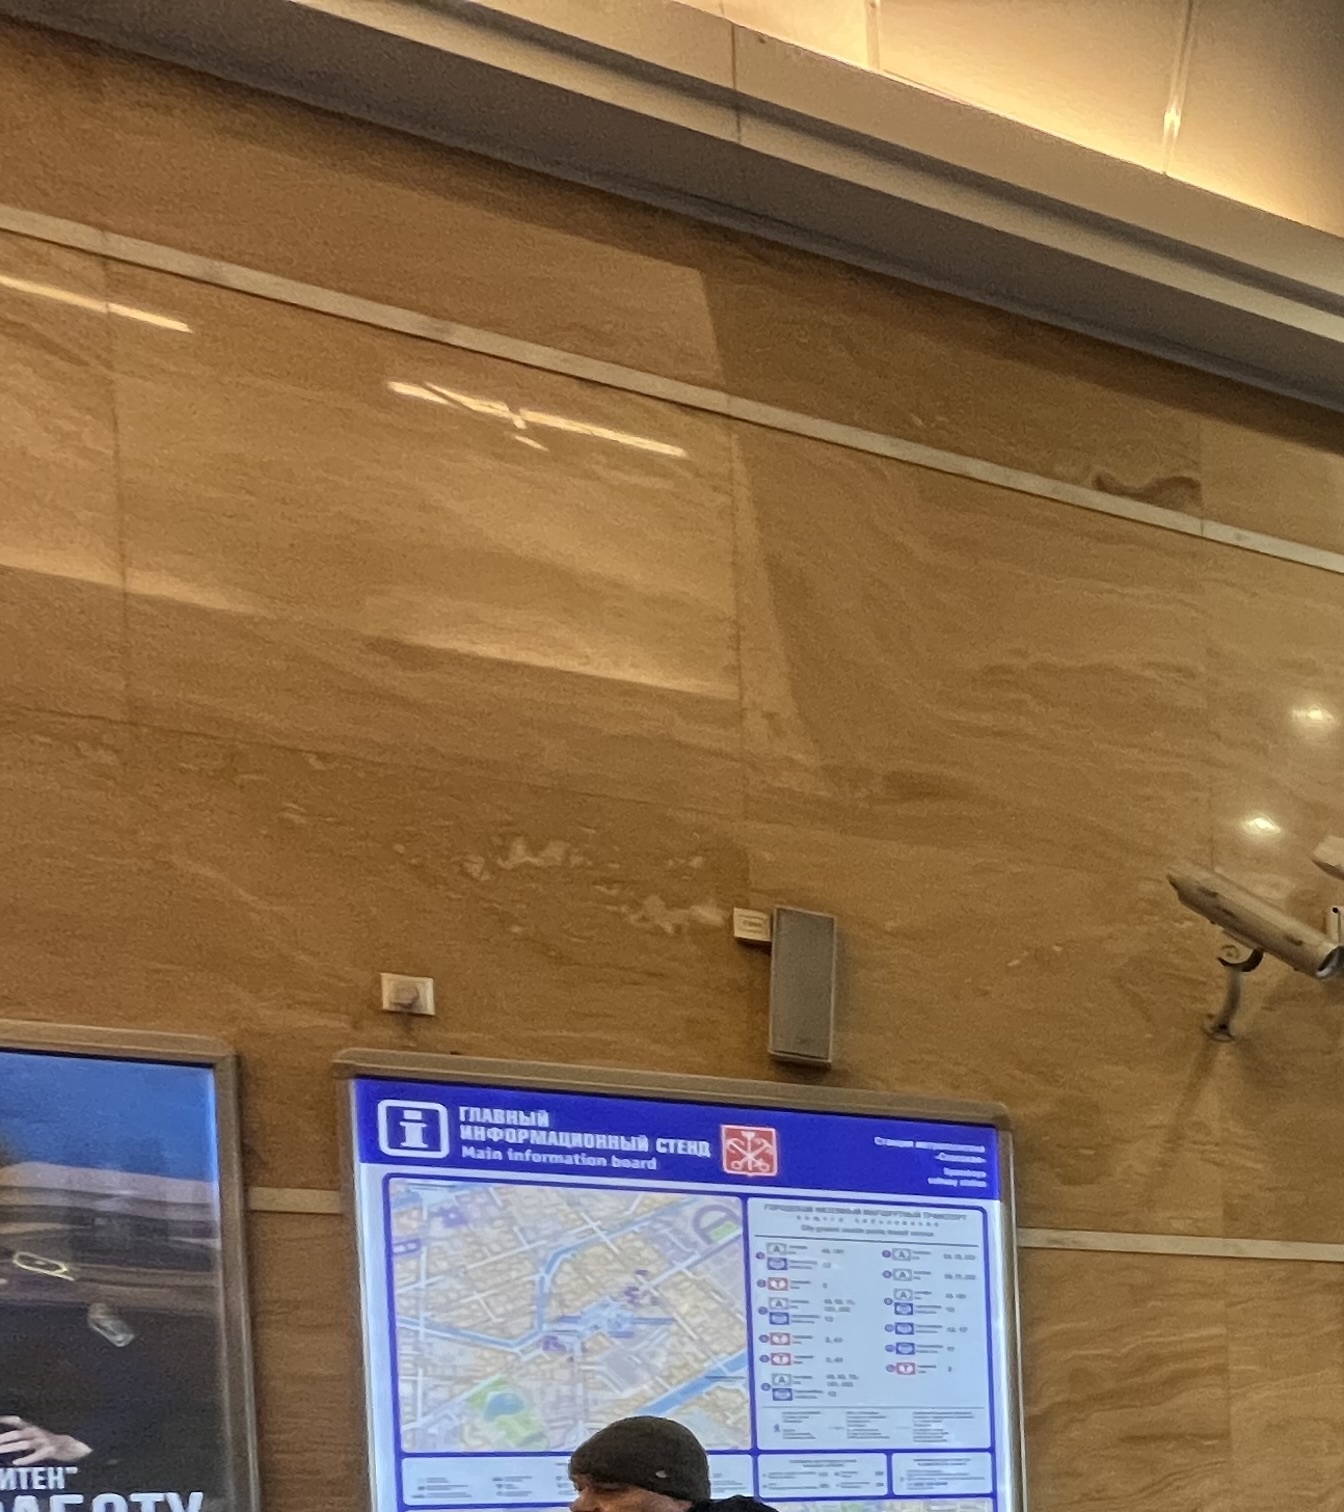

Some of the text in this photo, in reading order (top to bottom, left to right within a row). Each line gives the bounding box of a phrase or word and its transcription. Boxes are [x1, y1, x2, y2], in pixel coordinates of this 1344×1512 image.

[459, 1106, 549, 1128] ГЛАВНЫЙ
[460, 1124, 711, 1158] ИНФОРМАЦИОННЫЙ СТЕНД
[461, 1145, 657, 1171] Main information board
